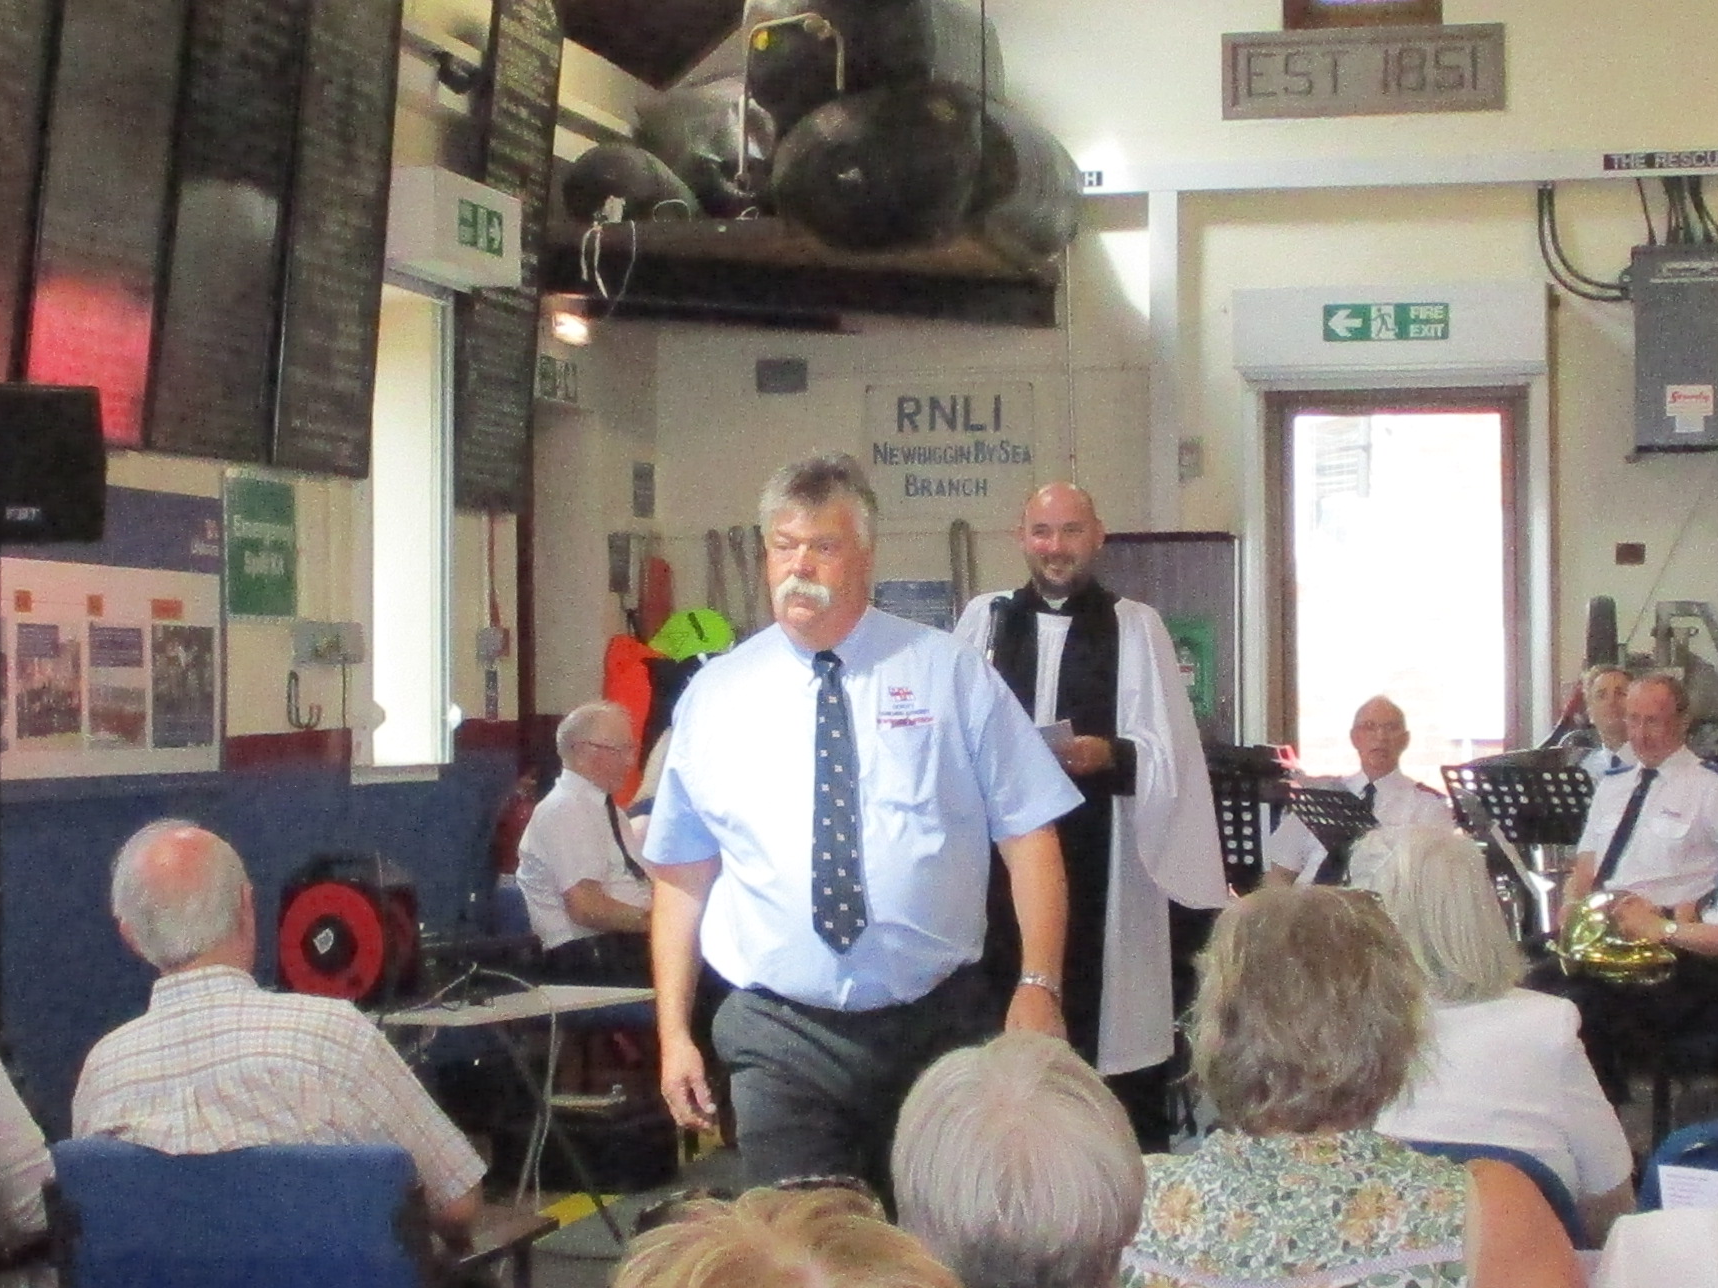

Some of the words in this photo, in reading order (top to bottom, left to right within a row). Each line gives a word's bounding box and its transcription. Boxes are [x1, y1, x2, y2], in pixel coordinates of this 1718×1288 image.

[1247, 49, 1349, 98] EST
[1382, 44, 1478, 96] 1851
[1610, 154, 1646, 169] THE
[1410, 306, 1444, 319] FIRE
[1410, 324, 1444, 337] EXIT
[897, 394, 1002, 432] RNLI
[905, 473, 988, 498] BRANCH
